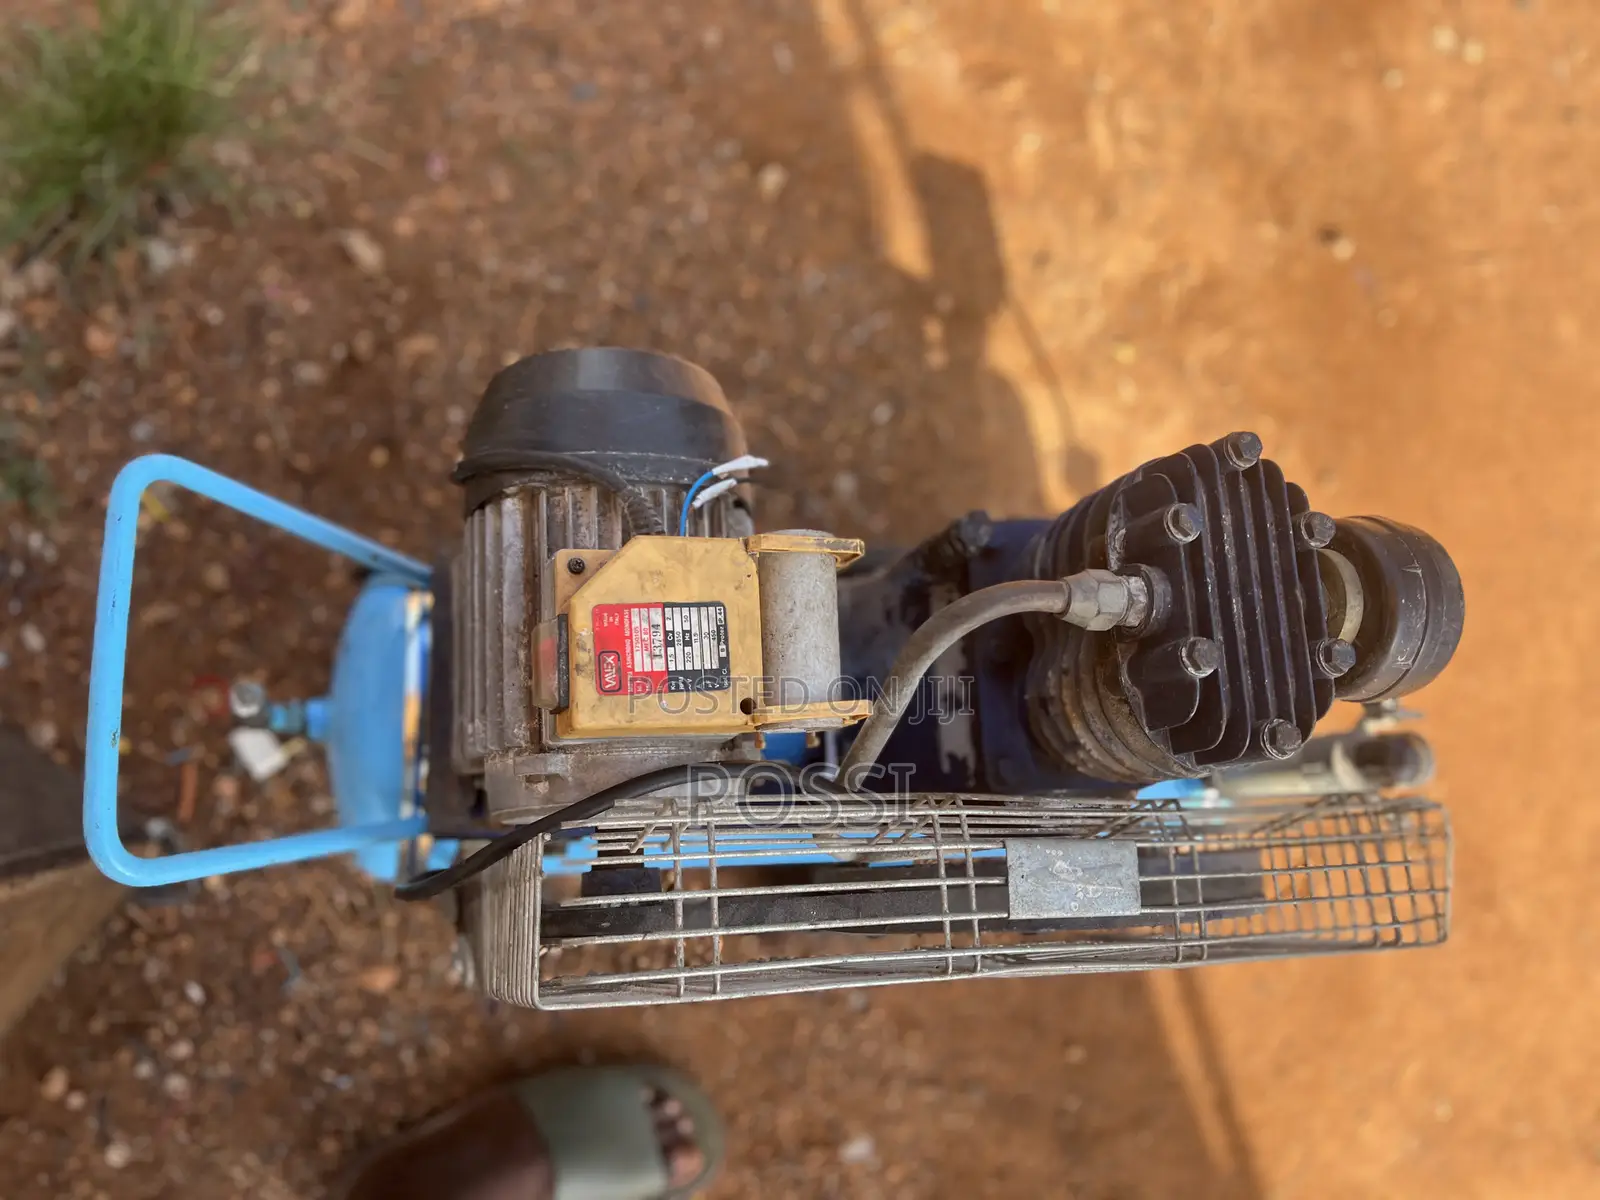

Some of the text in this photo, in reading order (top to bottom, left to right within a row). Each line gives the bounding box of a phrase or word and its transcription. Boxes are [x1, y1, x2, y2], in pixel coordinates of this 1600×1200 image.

[683, 614, 689, 623] 50
[703, 631, 709, 640] 30
[604, 655, 617, 688] VALEX
